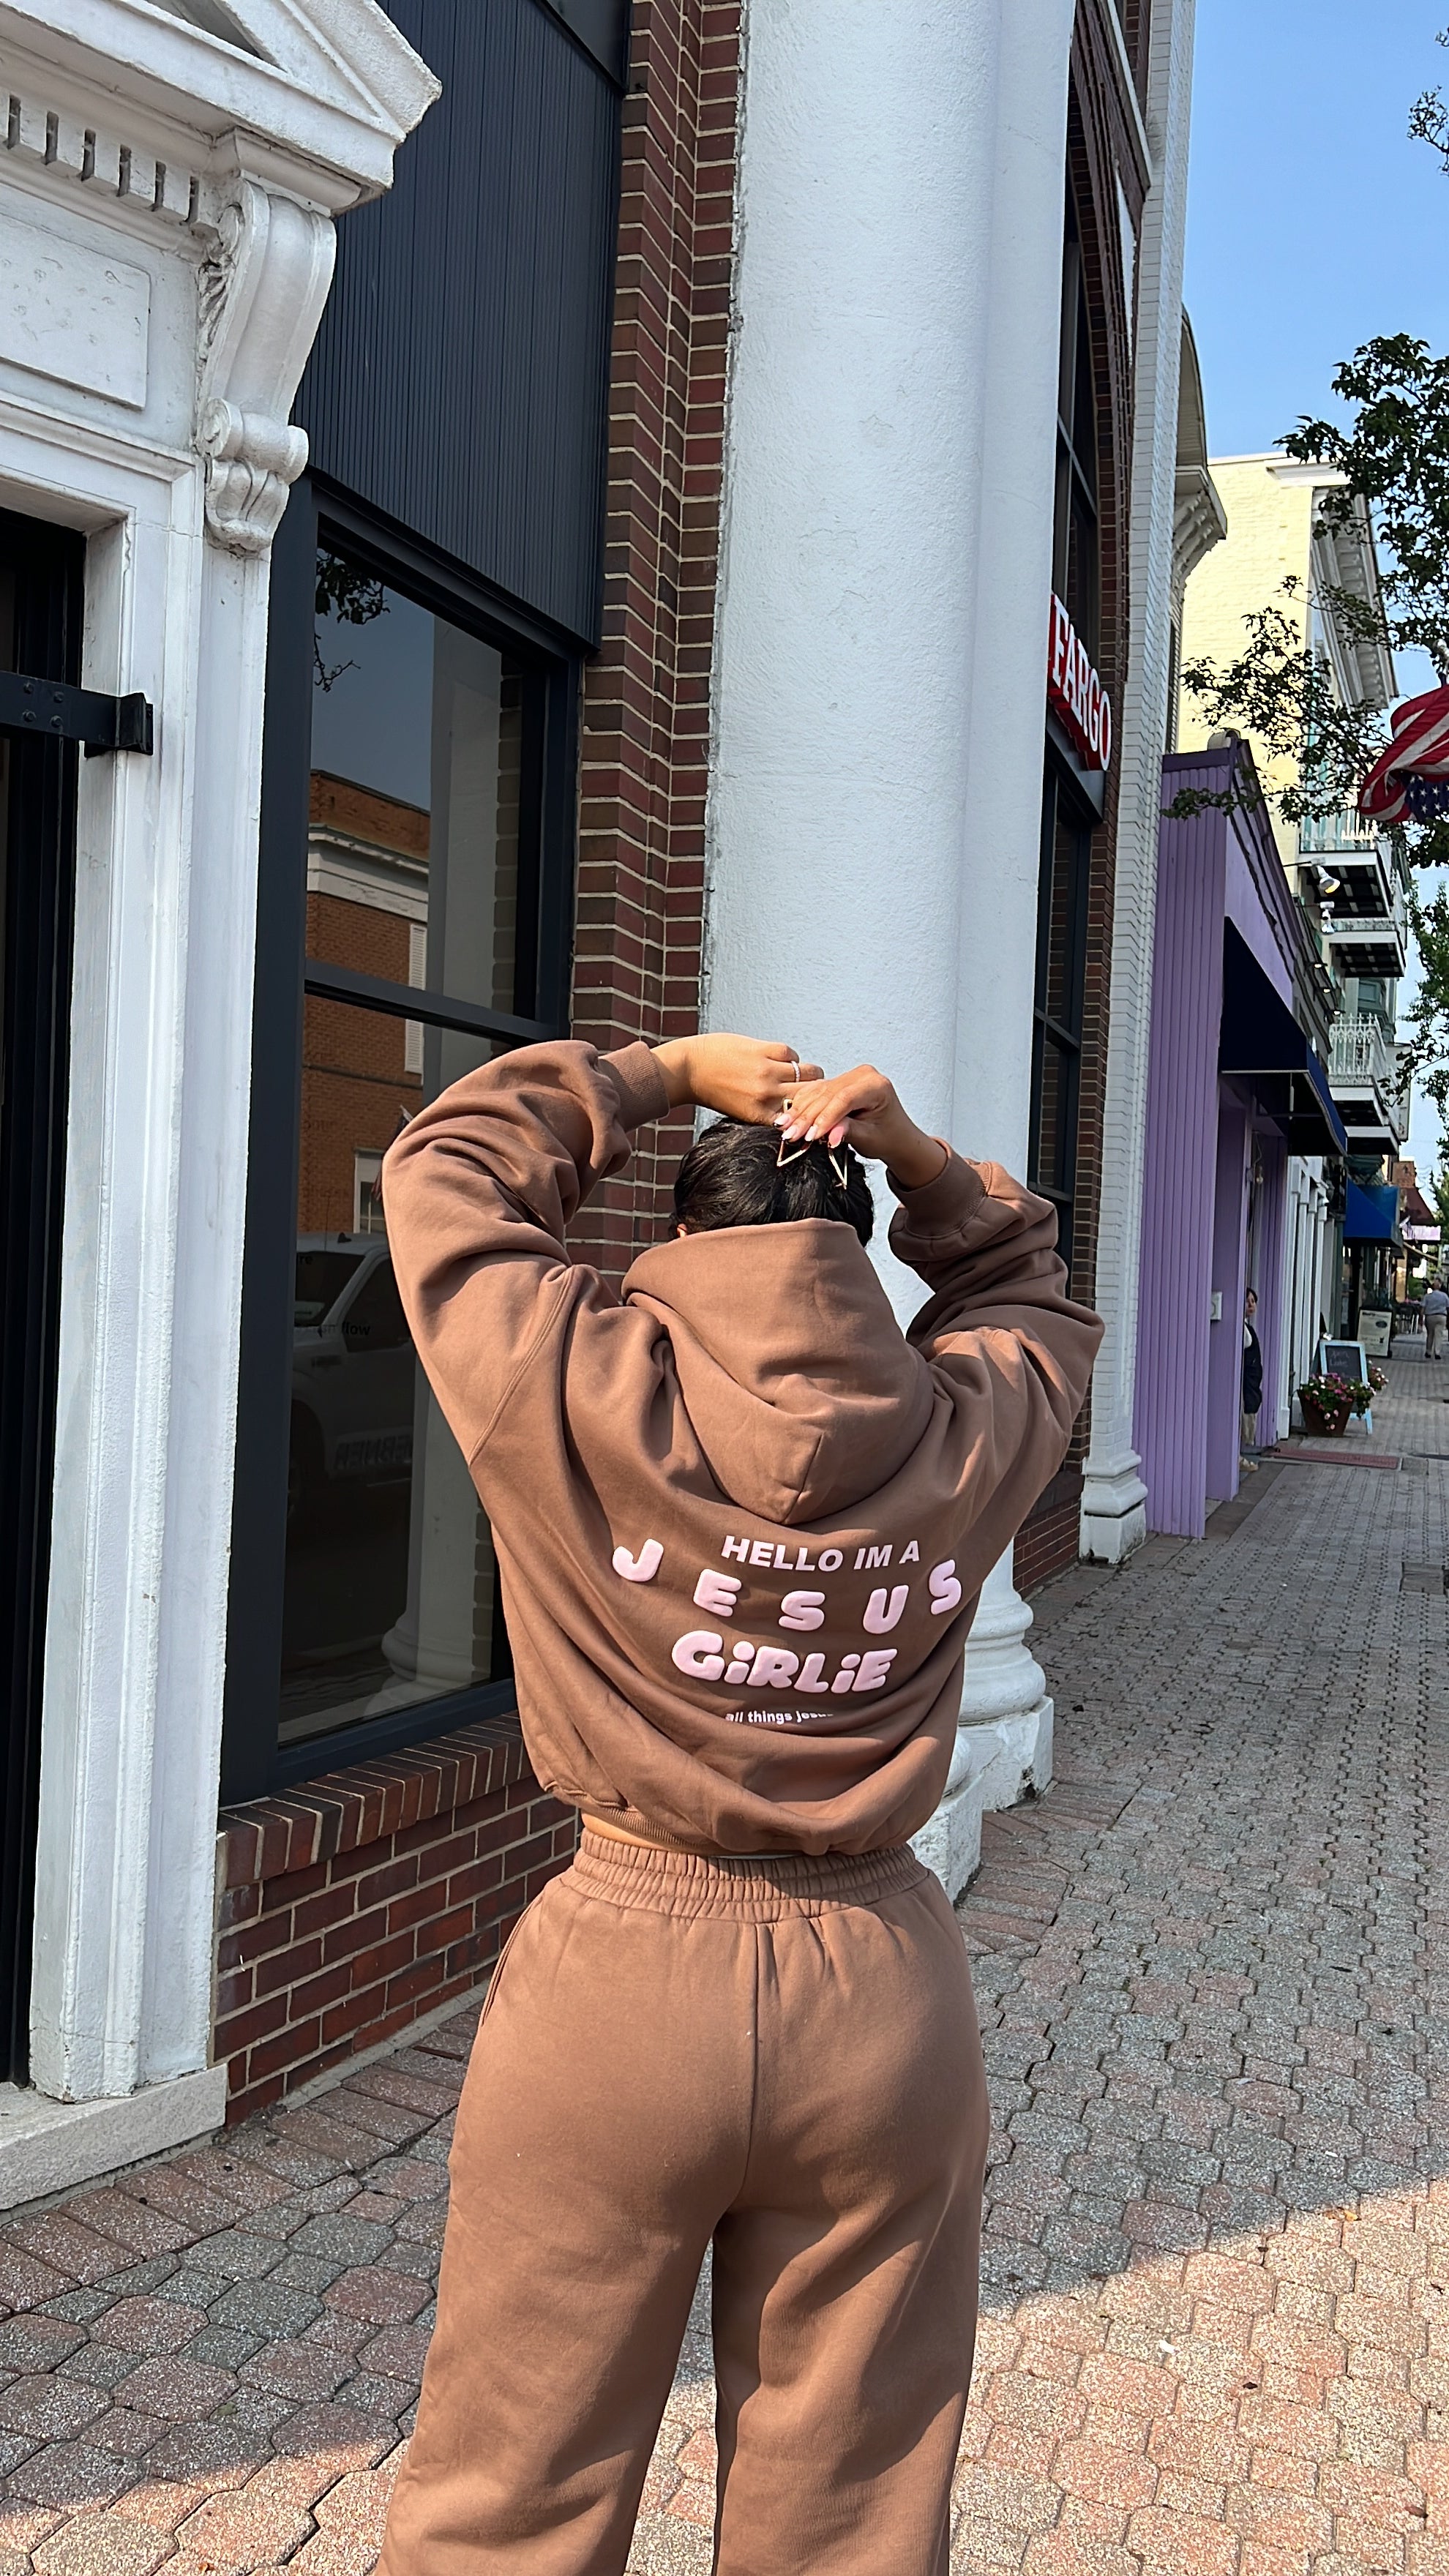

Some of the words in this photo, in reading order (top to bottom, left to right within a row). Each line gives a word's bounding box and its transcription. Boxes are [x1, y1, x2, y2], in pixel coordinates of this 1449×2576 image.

[1052, 594, 1112, 771] FARGO
[721, 1535, 843, 1572] HELLO
[853, 1544, 893, 1570] IM
[899, 1540, 920, 1564] A
[725, 1712, 744, 1723] all
[747, 1710, 793, 1725] things
